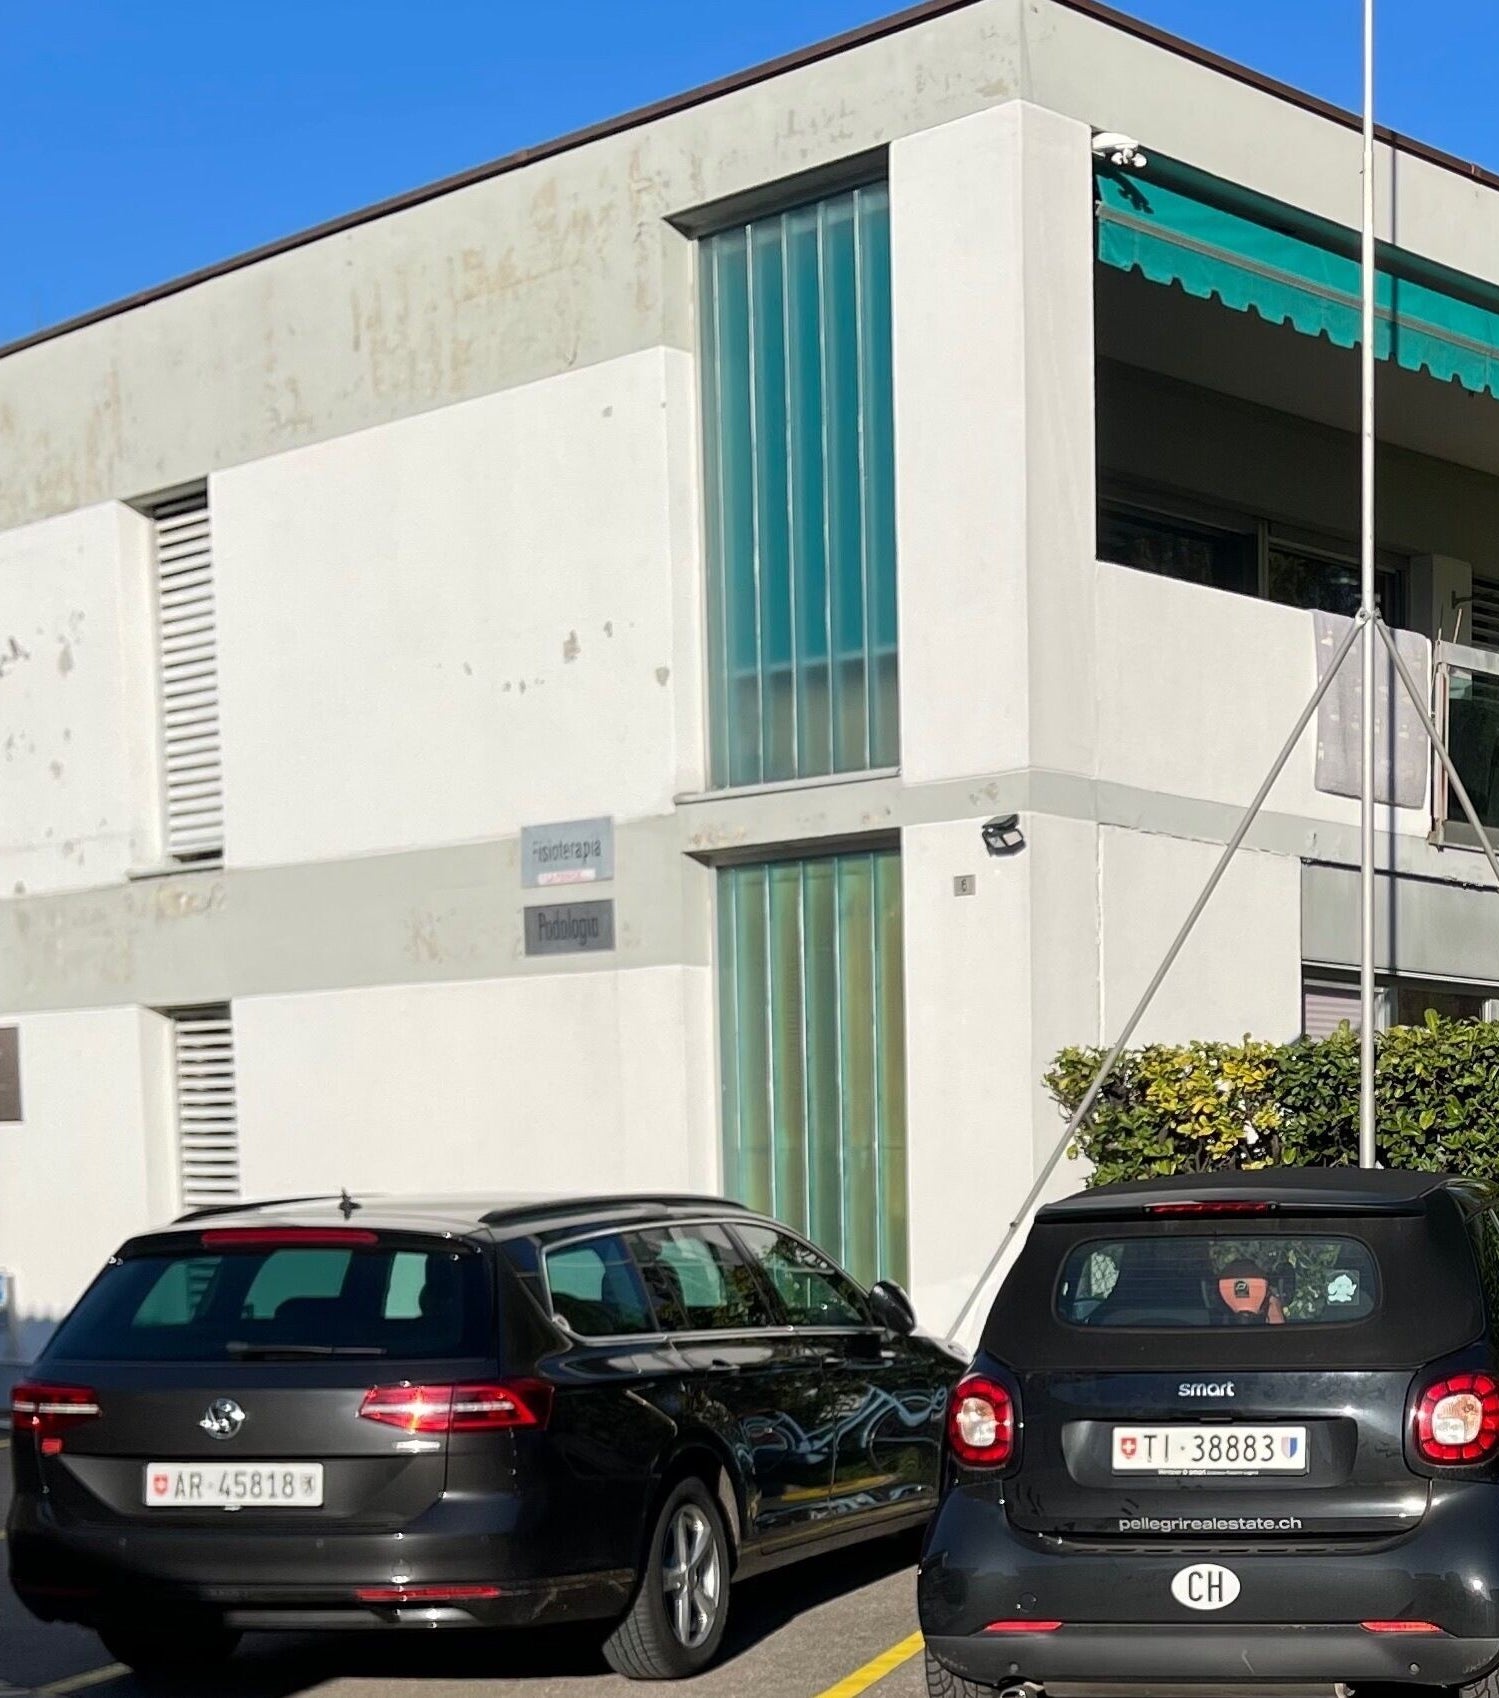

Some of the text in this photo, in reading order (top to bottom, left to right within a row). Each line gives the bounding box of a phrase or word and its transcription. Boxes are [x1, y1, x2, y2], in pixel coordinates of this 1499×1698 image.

[532, 839, 602, 864] Fisioterapia
[537, 911, 599, 946] Podologia
[1178, 1381, 1235, 1397] smart
[1119, 1517, 1302, 1533] pellegrirealestate.ch
[1188, 1570, 1224, 1602] CH
